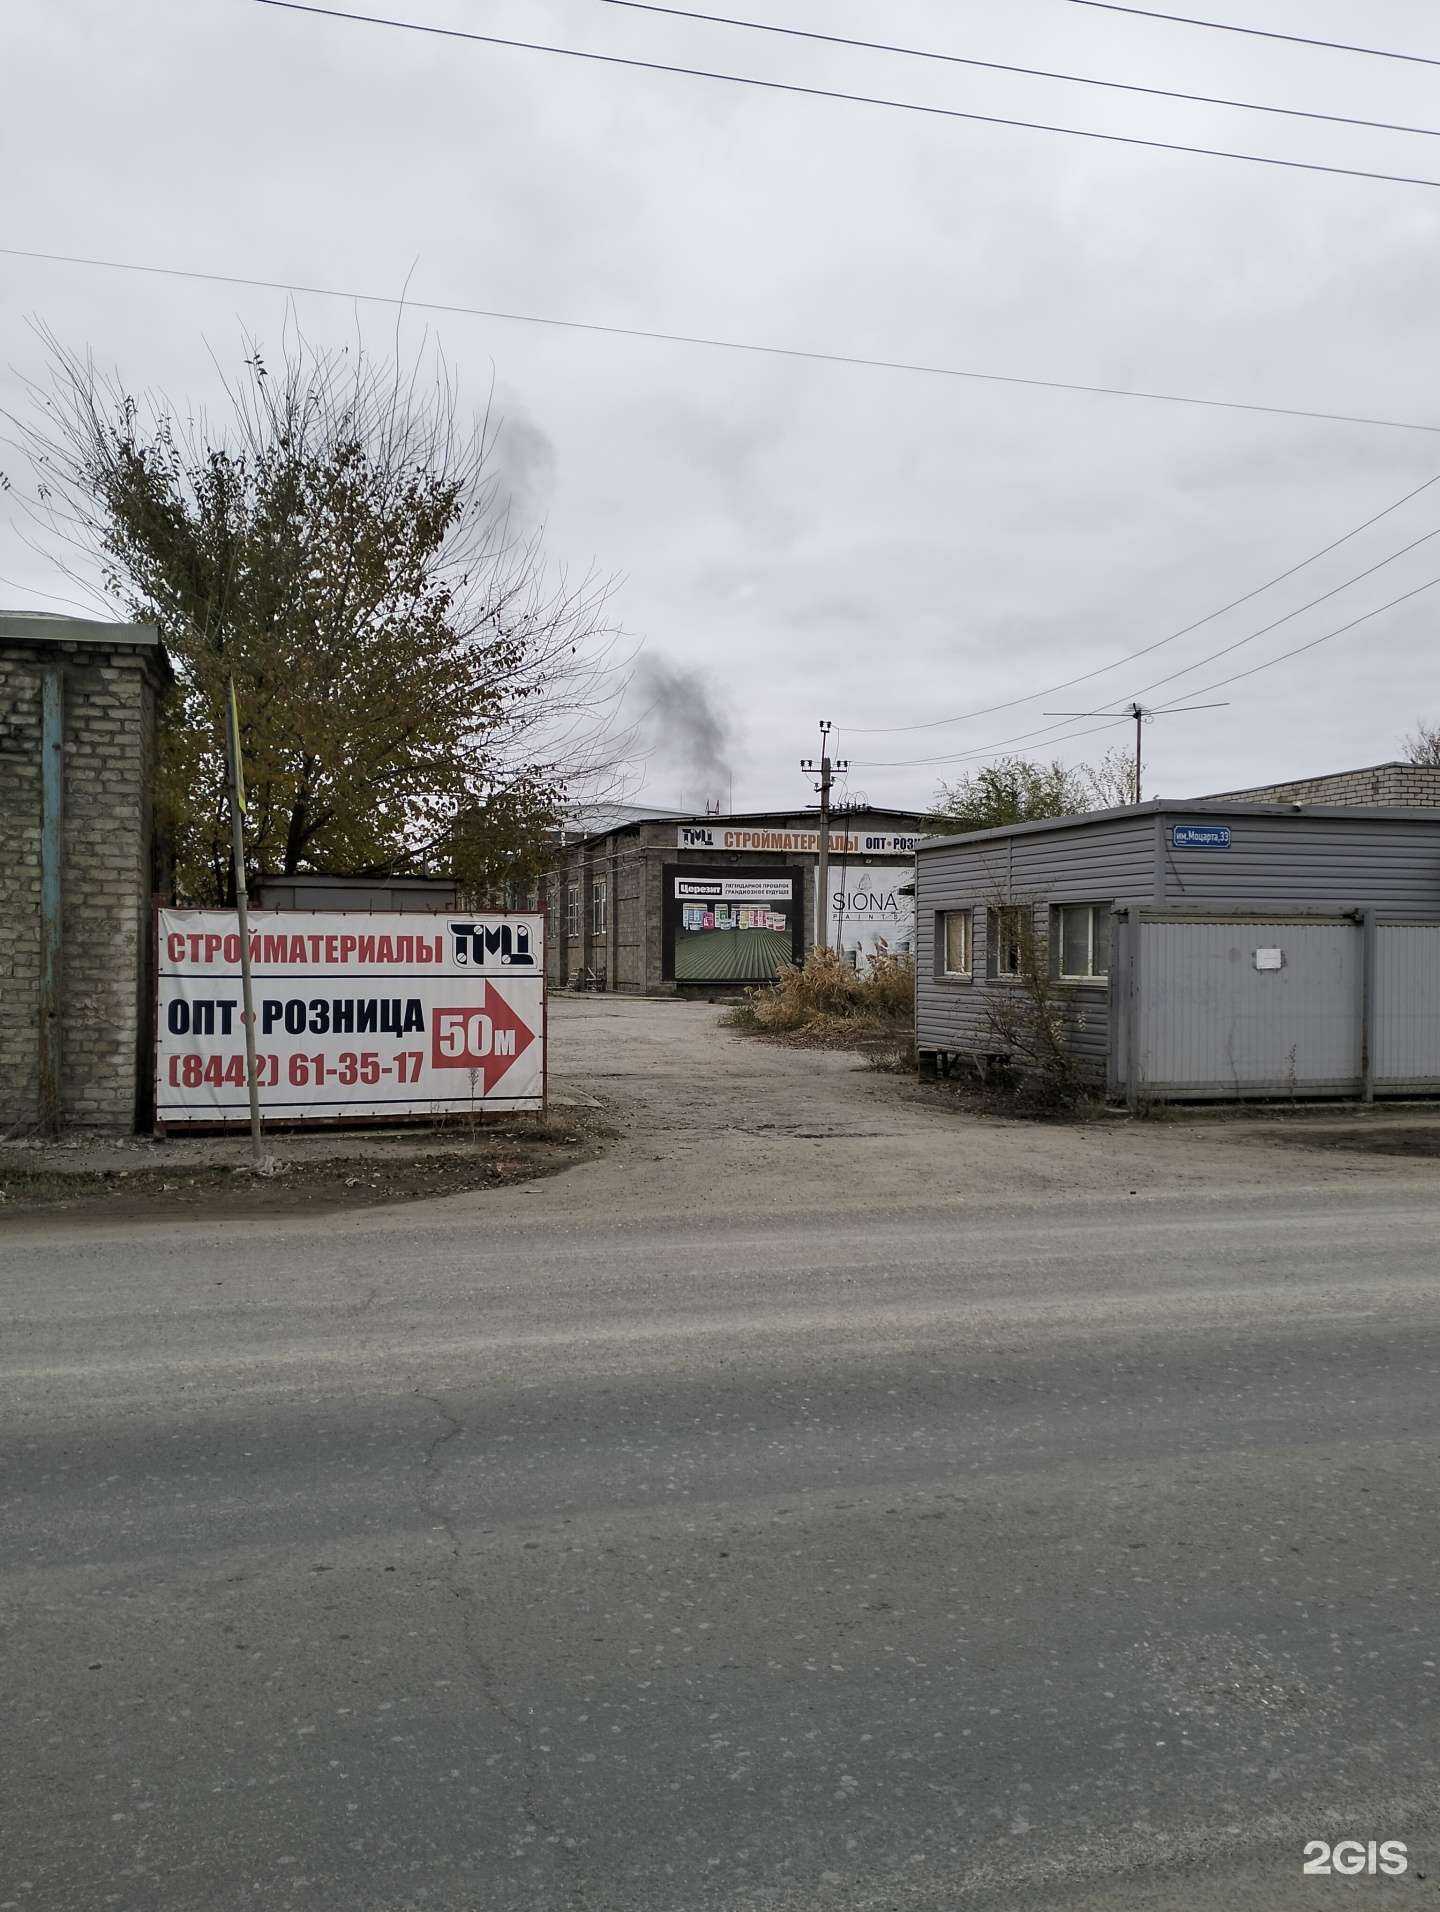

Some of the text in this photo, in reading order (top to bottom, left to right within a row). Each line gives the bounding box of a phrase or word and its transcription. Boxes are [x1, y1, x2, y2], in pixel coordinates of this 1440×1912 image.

[866, 837, 886, 850] ОПТ
[893, 837, 921, 850] РОЗ
[832, 892, 898, 911] SIONA
[167, 929, 443, 964] СТРОЙМАТЕРИАЛЫ
[168, 998, 425, 1038] ОПТ РОЗНИЦА
[168, 1051, 424, 1088] (8442) 61-35-17
